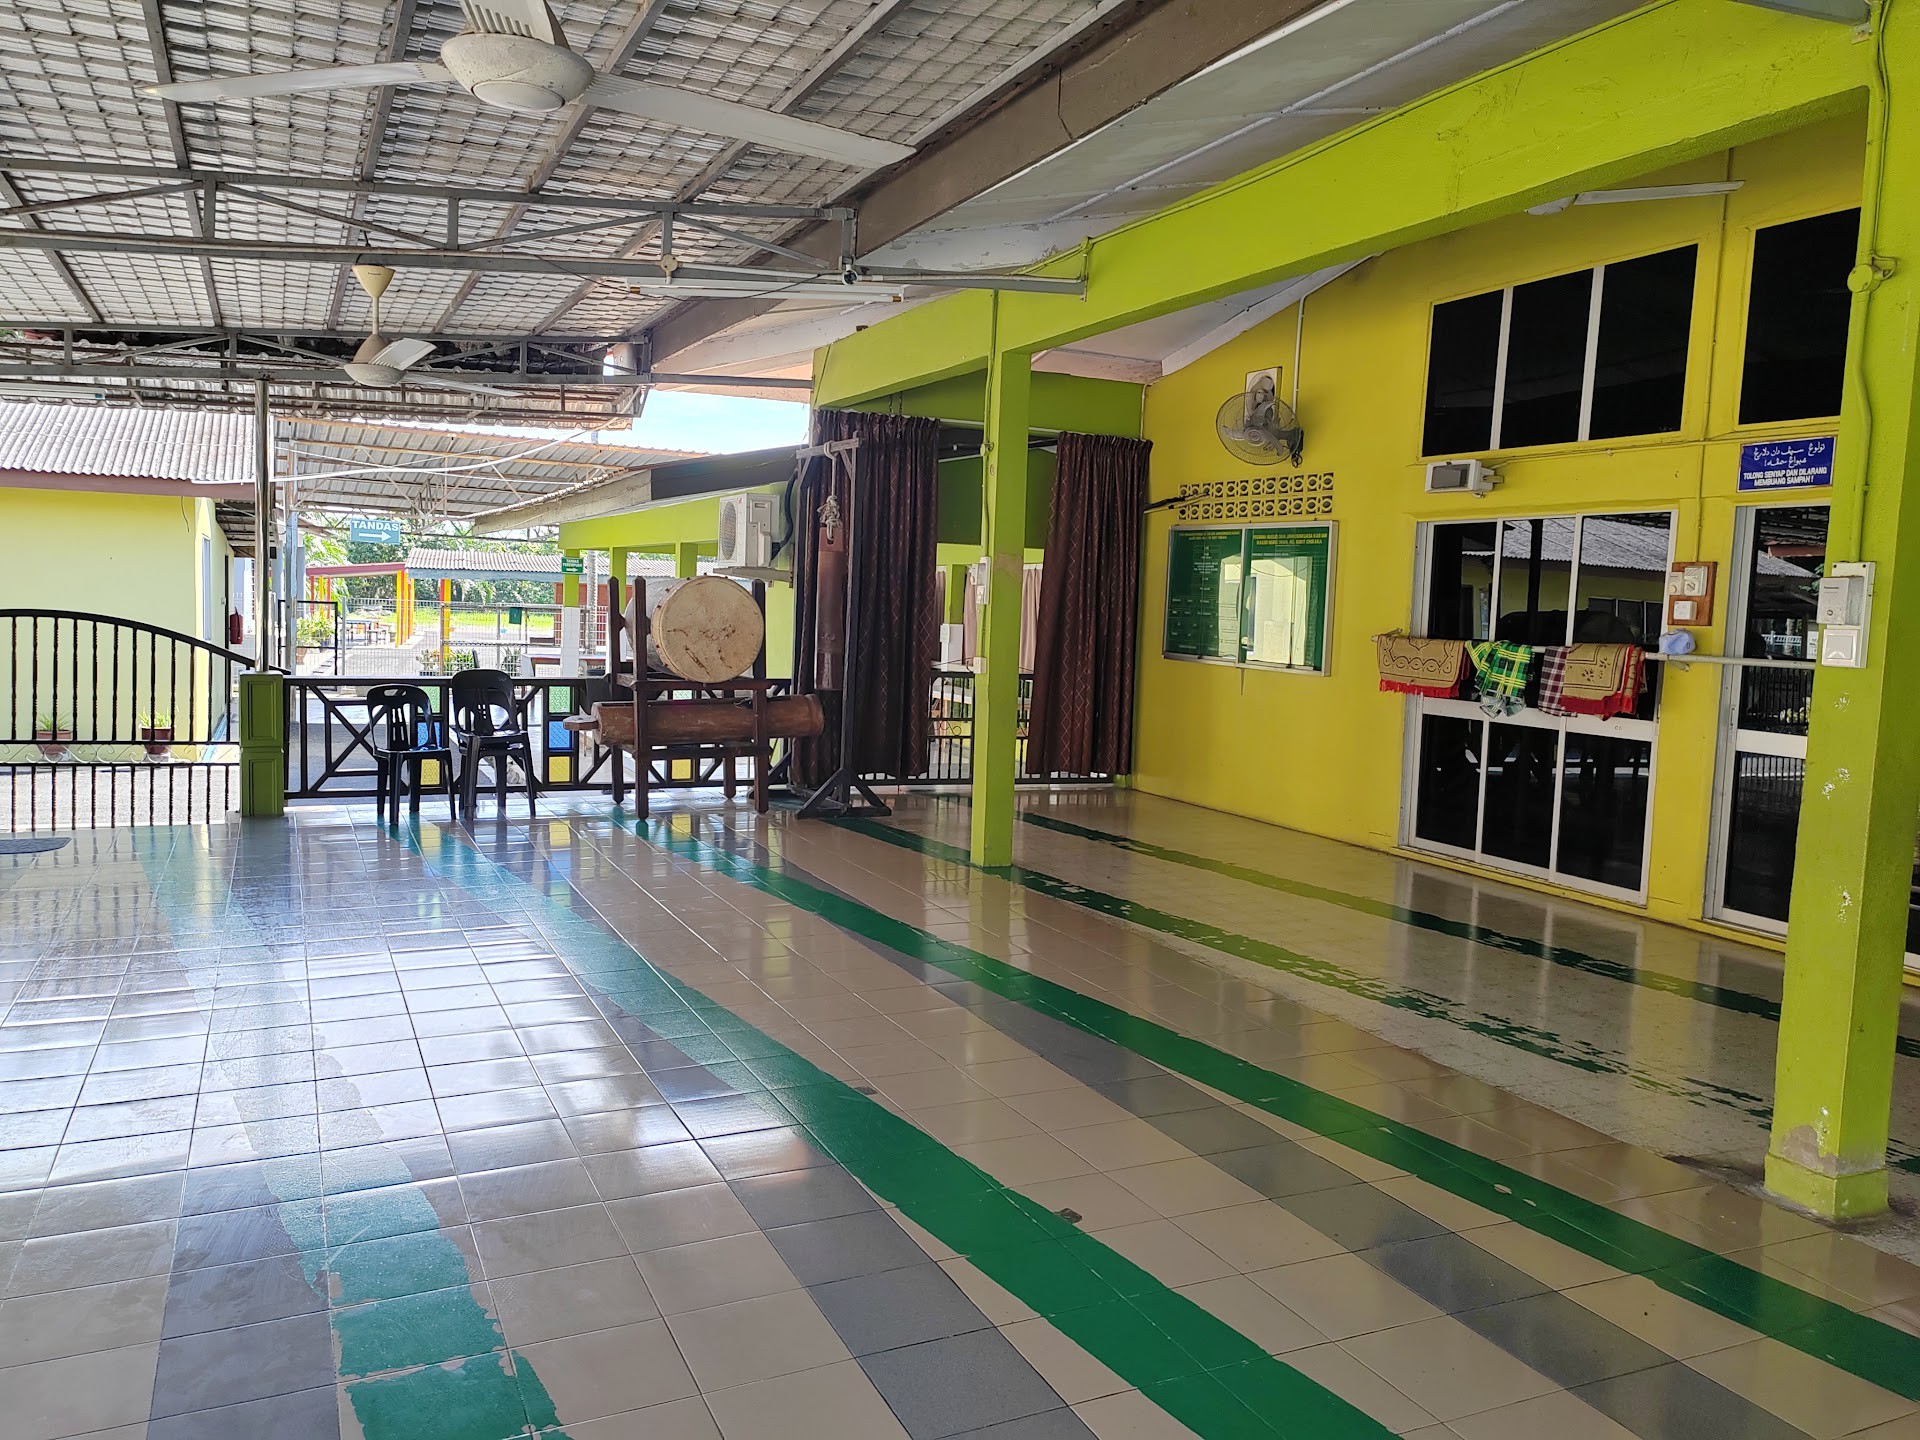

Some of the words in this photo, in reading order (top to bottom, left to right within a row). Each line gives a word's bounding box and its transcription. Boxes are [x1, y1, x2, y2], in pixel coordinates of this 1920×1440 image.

[1743, 472, 1764, 480] TOLONG
[1764, 470, 1785, 479] SENYAP
[1786, 468, 1798, 476] DAN
[1799, 467, 1827, 475] DILARANG
[1754, 477, 1786, 486] MEMBUANG
[1787, 475, 1811, 485] SAMPAH
[351, 520, 399, 532] TANDAS
